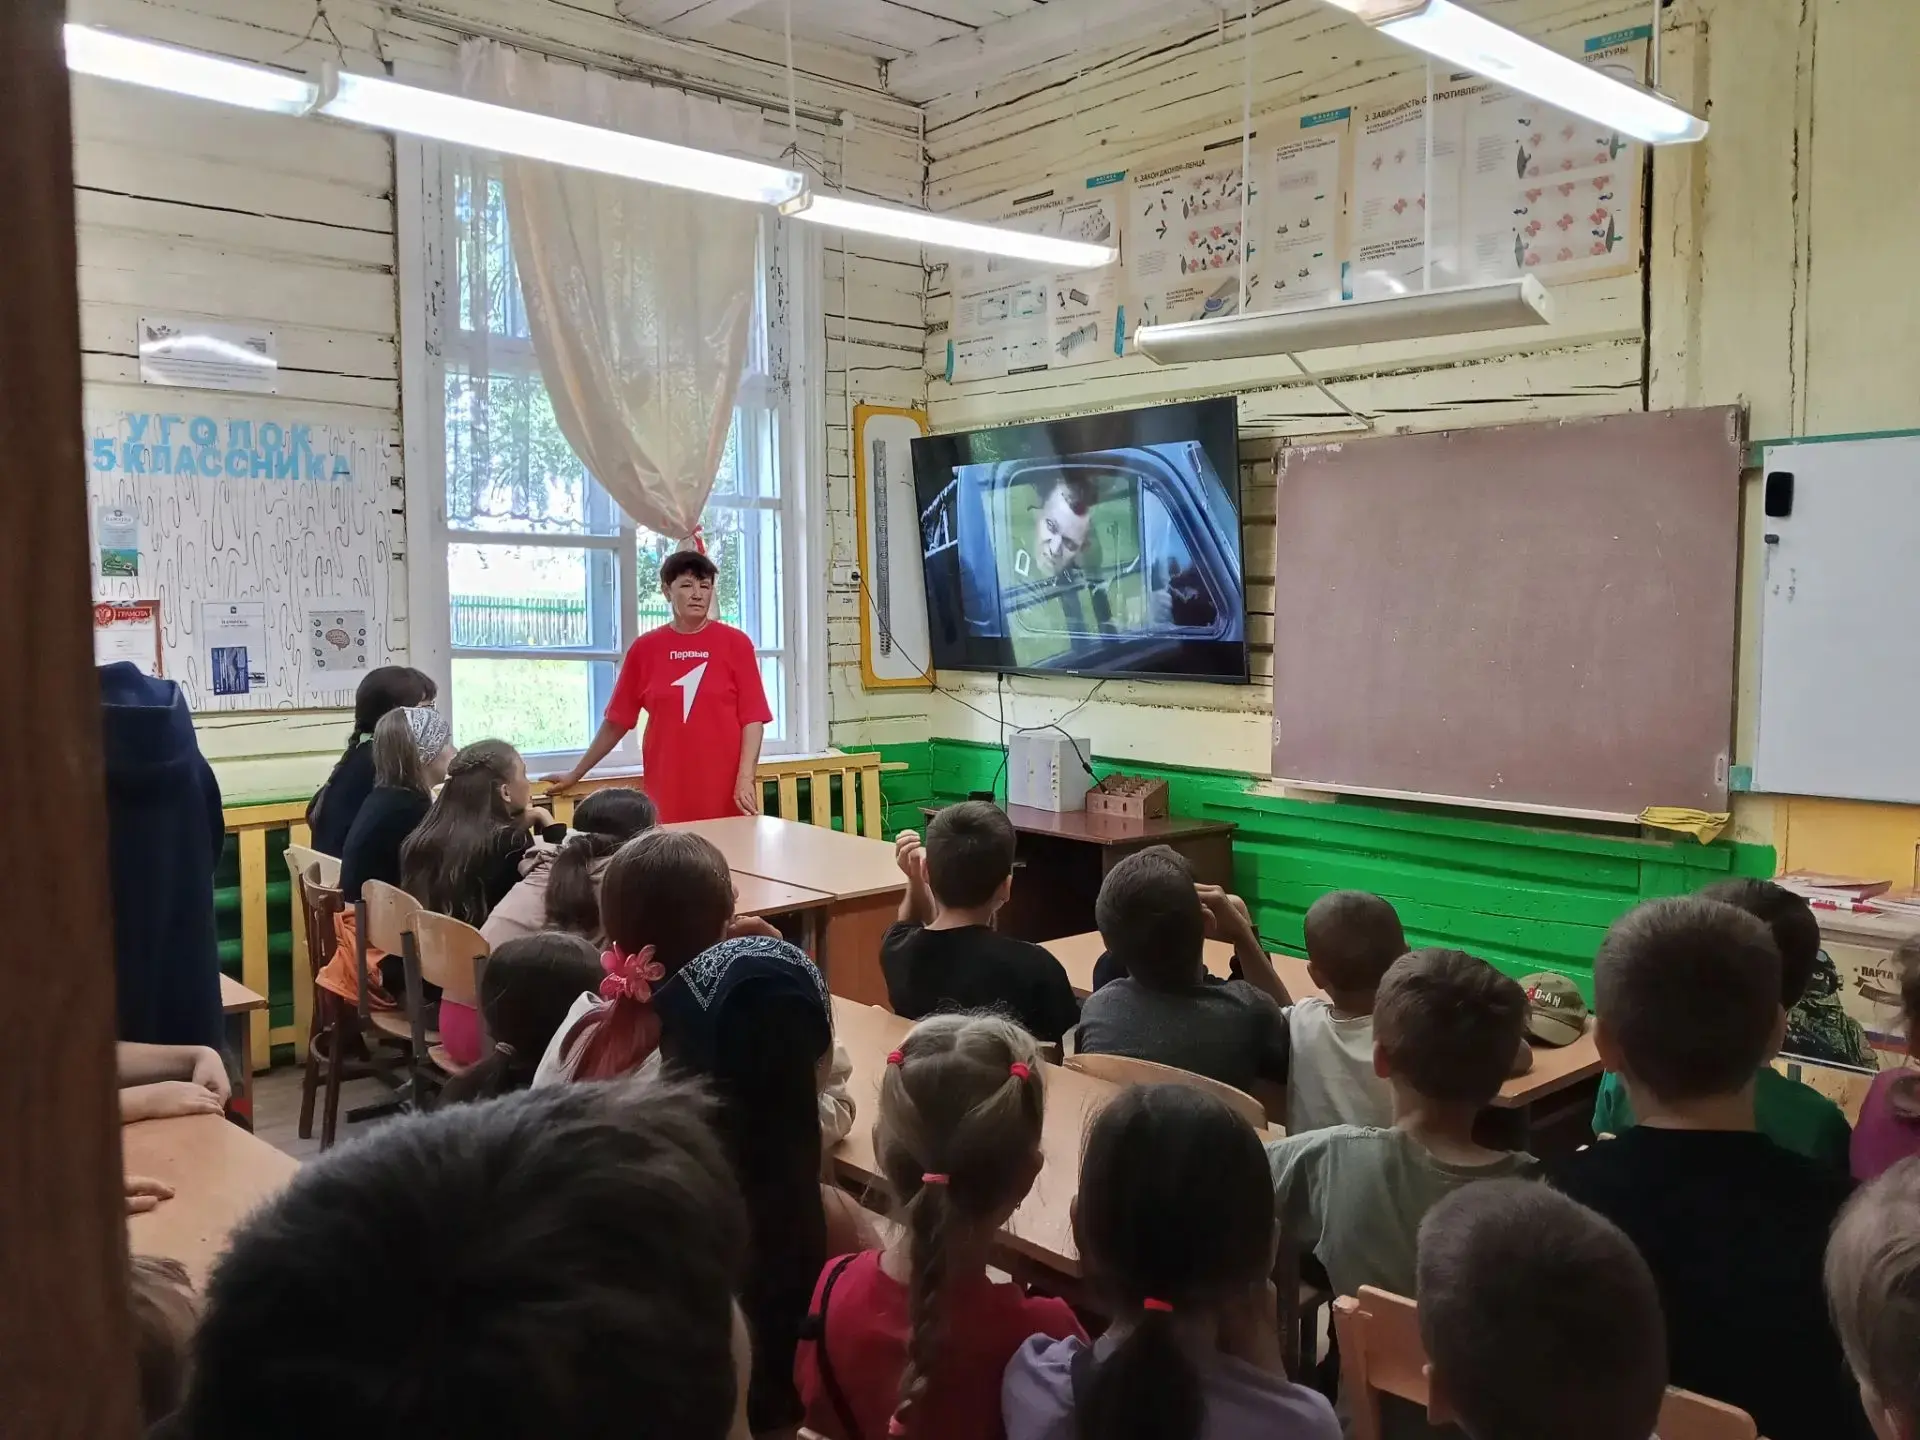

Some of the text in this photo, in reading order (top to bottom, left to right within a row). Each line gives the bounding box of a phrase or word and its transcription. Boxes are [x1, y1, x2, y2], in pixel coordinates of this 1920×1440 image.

[127, 413, 312, 452] УГОЛОК
[117, 608, 149, 618] ГРАМОТА
[669, 650, 710, 661] Первые
[1861, 966, 1894, 979] ПАРТА
